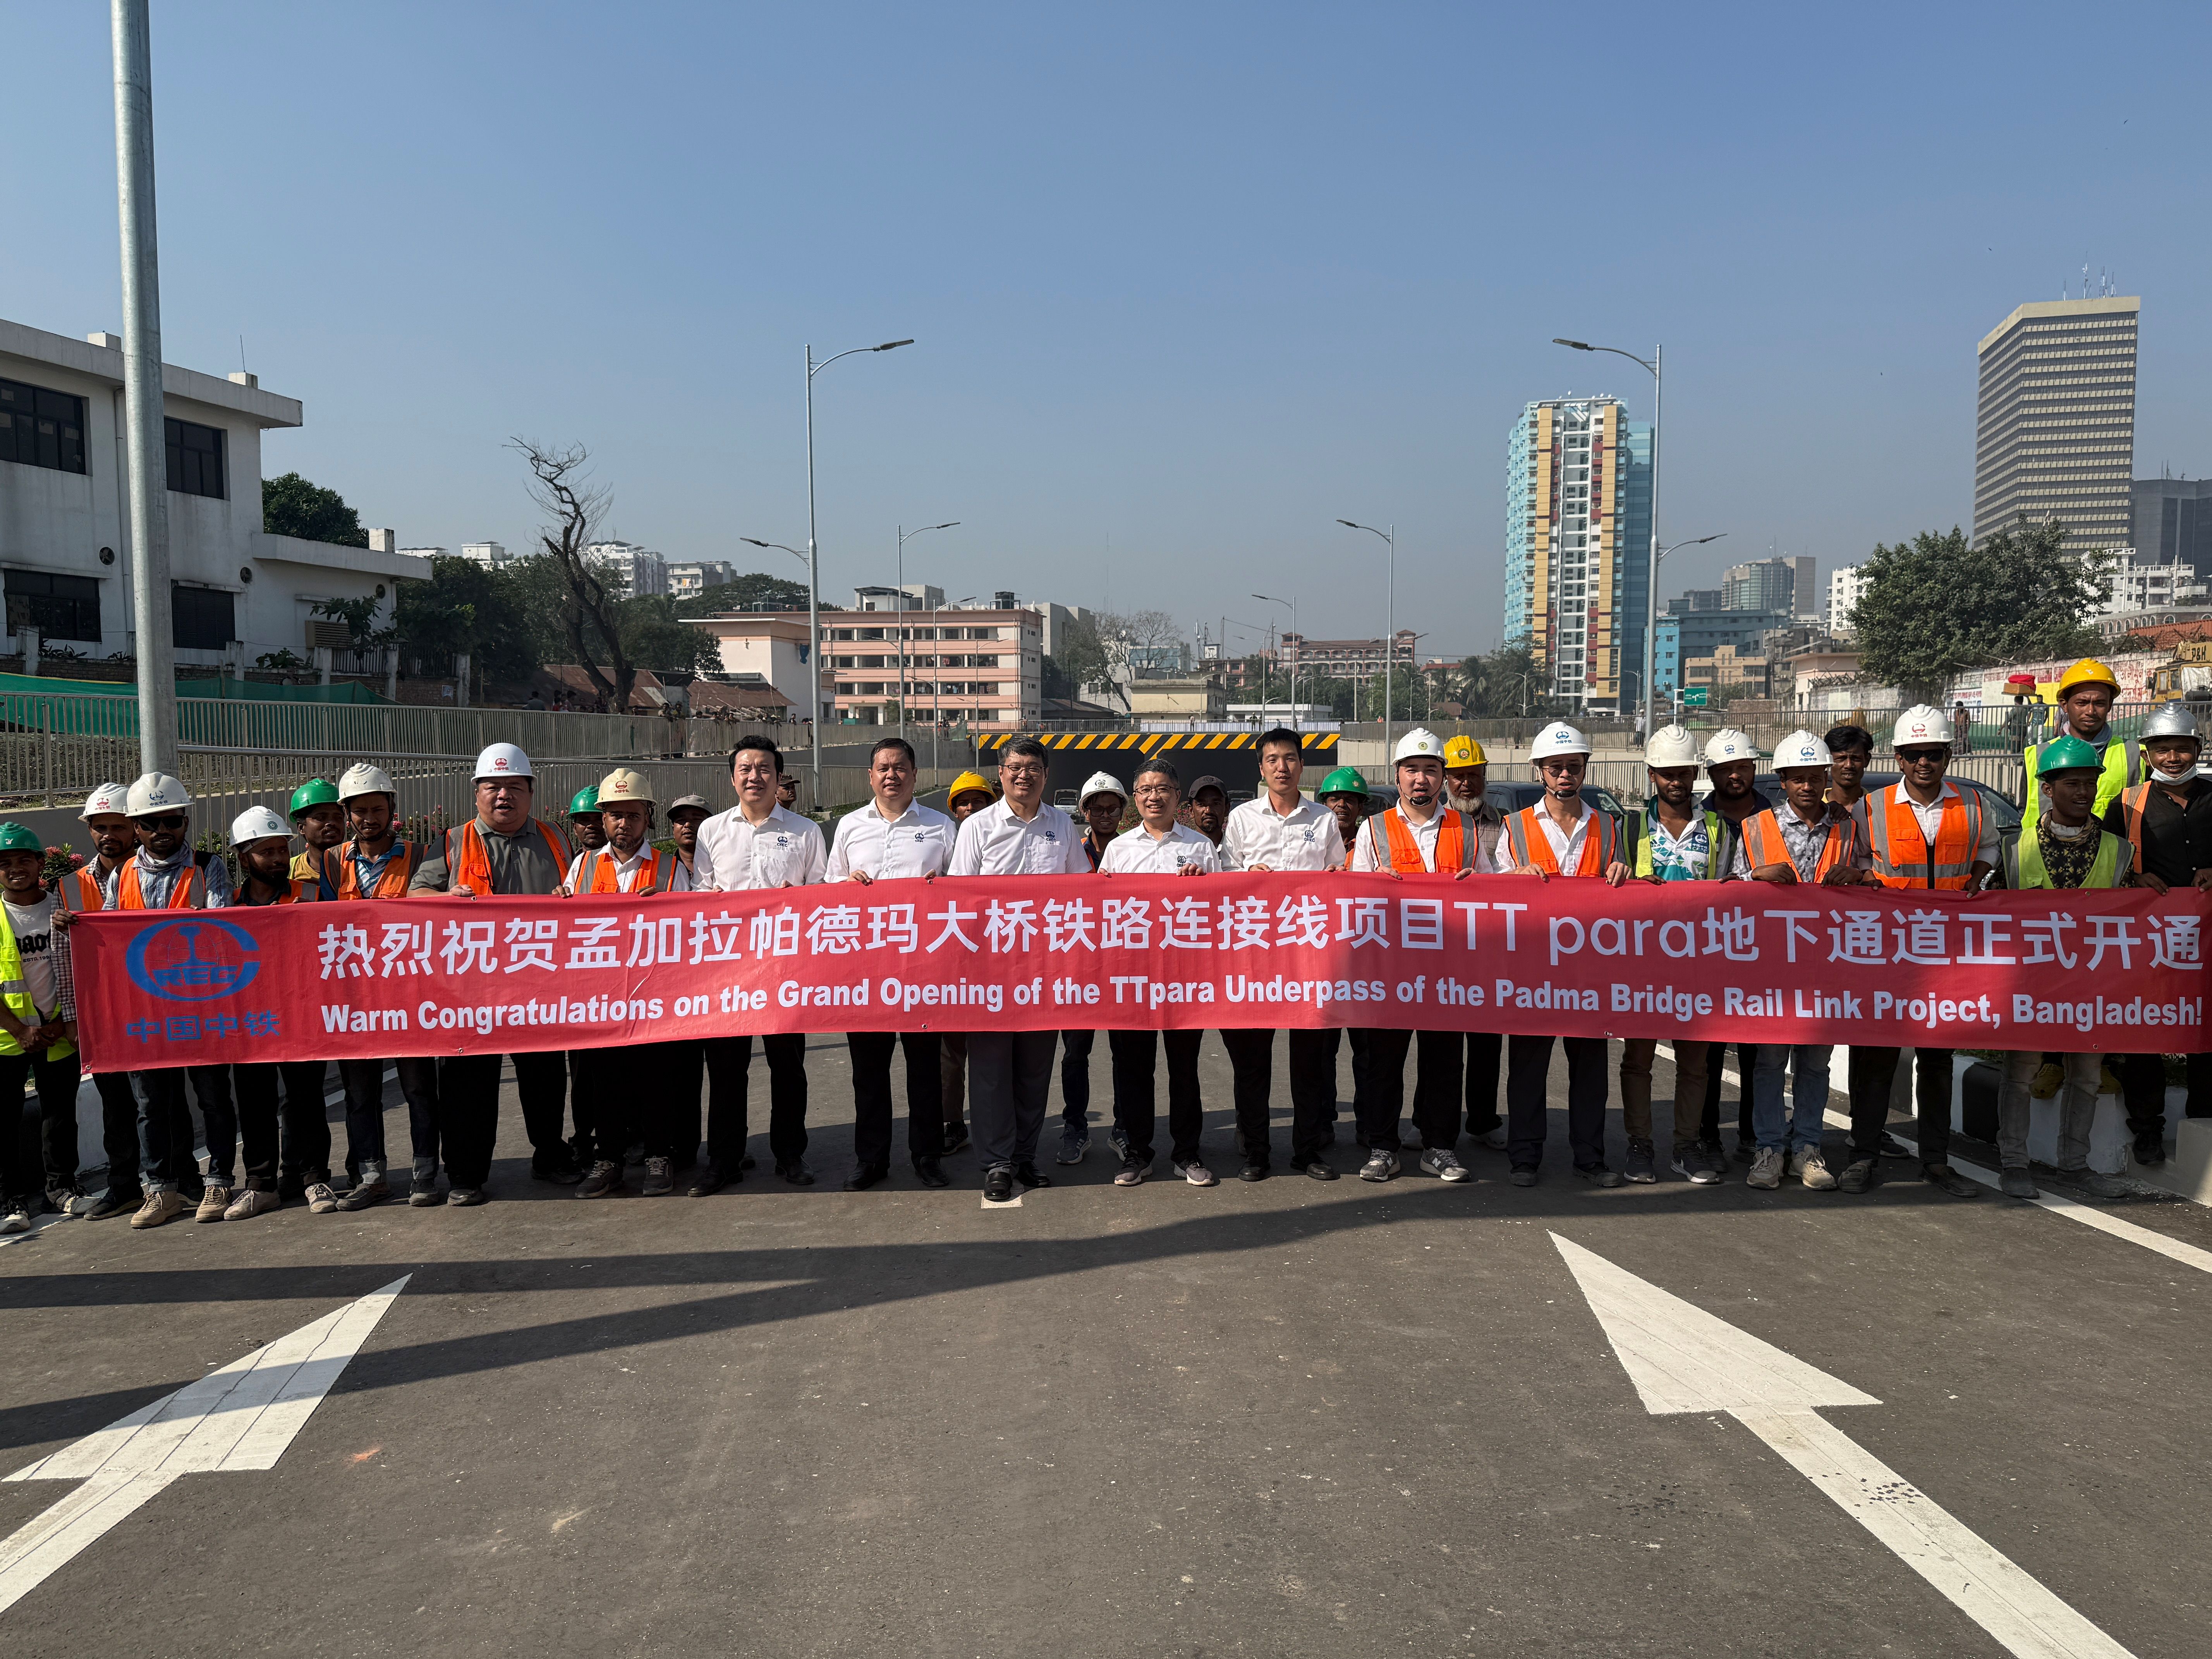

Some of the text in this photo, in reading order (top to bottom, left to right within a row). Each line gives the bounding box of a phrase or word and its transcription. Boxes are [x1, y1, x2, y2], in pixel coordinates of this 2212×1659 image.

[2191, 645, 2206, 661] P&H
[321, 974, 2202, 1035] Warm Congratulations on the Grand Opening of the TTpara Underpass of the Padma Bridge Rail Link Project, Bangladesh!
[126, 1010, 280, 1043] 中国中铁
